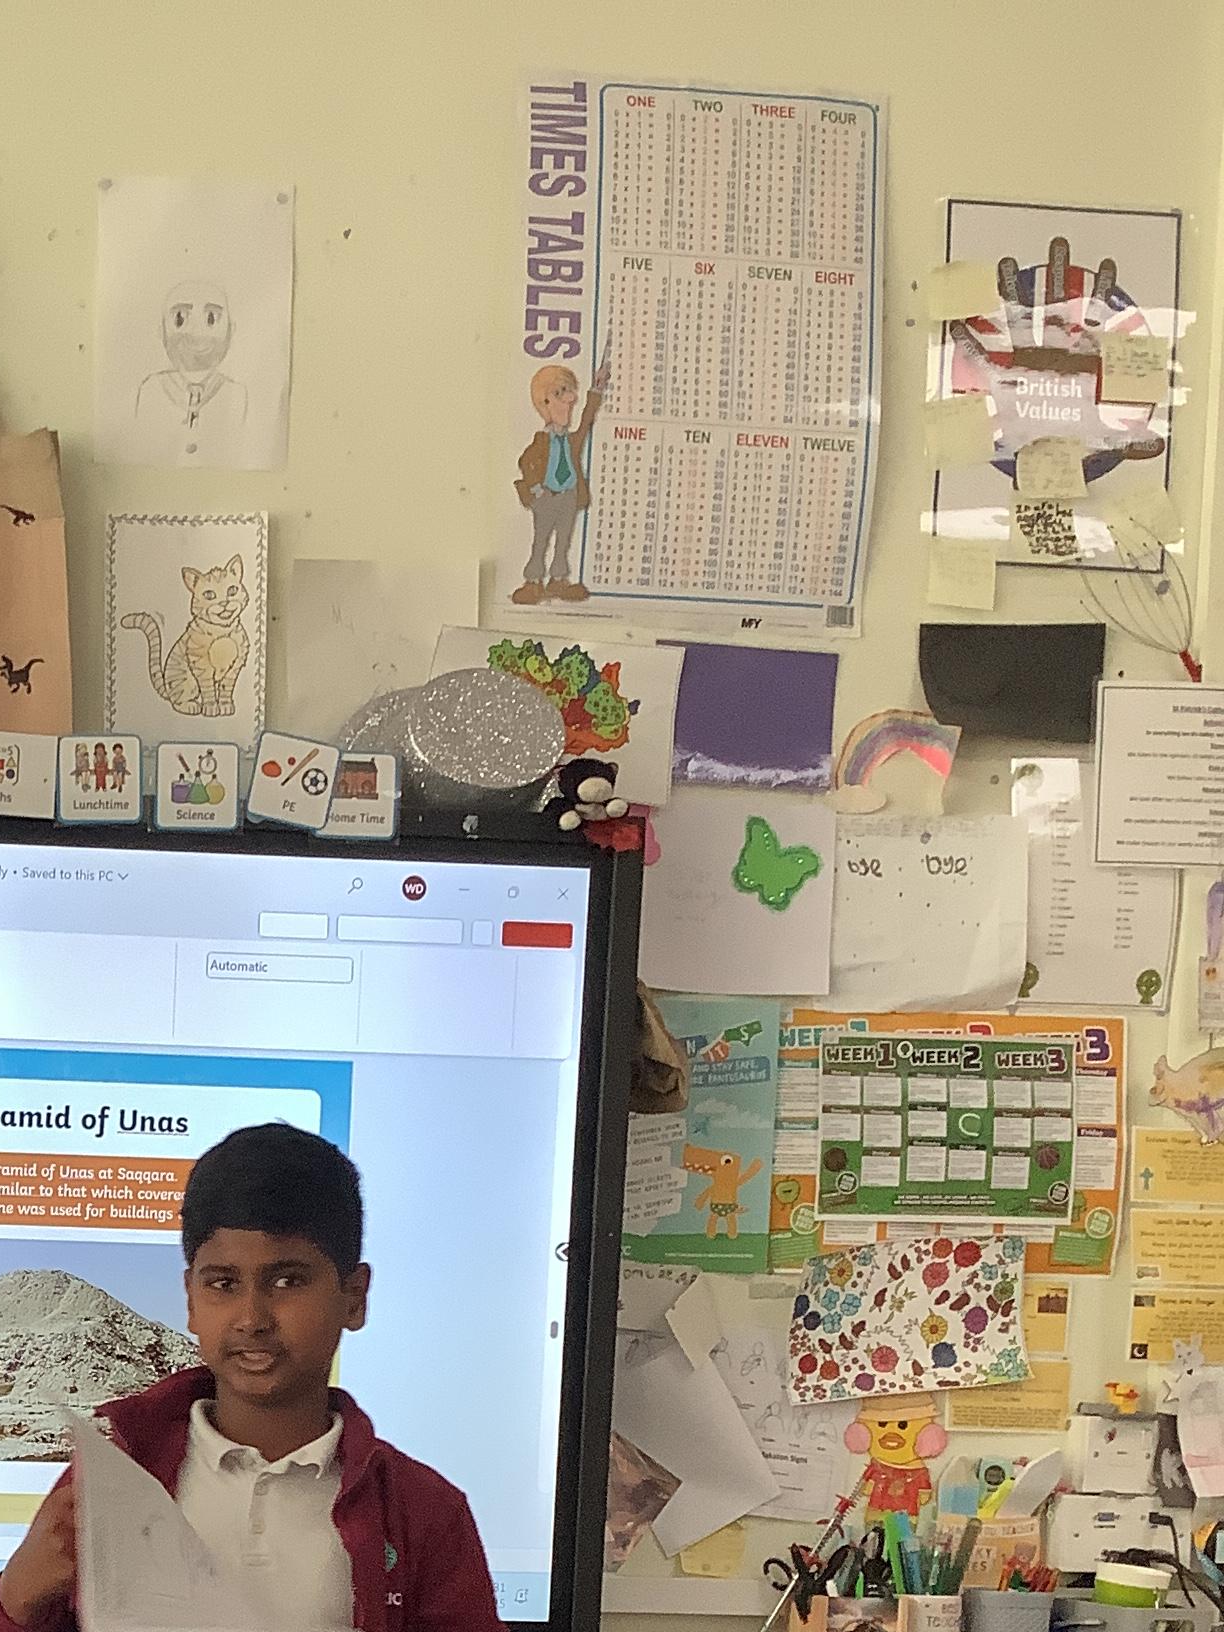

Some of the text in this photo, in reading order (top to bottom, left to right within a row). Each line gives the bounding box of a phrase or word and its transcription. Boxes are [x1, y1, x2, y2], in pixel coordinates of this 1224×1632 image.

[626, 96, 856, 125] ONE TWO THREE FOUR
[524, 82, 587, 359] TIMES TABLES
[623, 257, 855, 286] FIVE SIX SEVEN EIGHT
[1015, 377, 1082, 398] British
[1016, 400, 1081, 421] Values
[614, 427, 854, 452] NINE TEN ELEVEN TWELVE
[73, 799, 129, 810] Lunchtime
[176, 809, 216, 821] Science
[282, 800, 296, 812] PE
[360, 813, 385, 824] Time
[22, 867, 56, 881] Saved
[59, 869, 72, 881] to
[75, 869, 96, 882] this
[98, 871, 113, 882] PC
[926, 854, 967, 875] bye
[404, 884, 424, 894] WD
[210, 960, 268, 973] Automatic
[827, 1044, 893, 1067] WEEK 1
[912, 1047, 980, 1068] WEEK 2
[997, 1050, 1064, 1071] WEEK 3
[81, 1106, 110, 1137] of
[119, 1110, 189, 1134] Unas
[60, 1166, 94, 1179] Unas
[117, 1167, 177, 1184] Saqqara.
[58, 1183, 87, 1199] that
[91, 1185, 133, 1200] which
[50, 1203, 81, 1217] used
[85, 1203, 105, 1220] for
[110, 1204, 173, 1222] buildings
